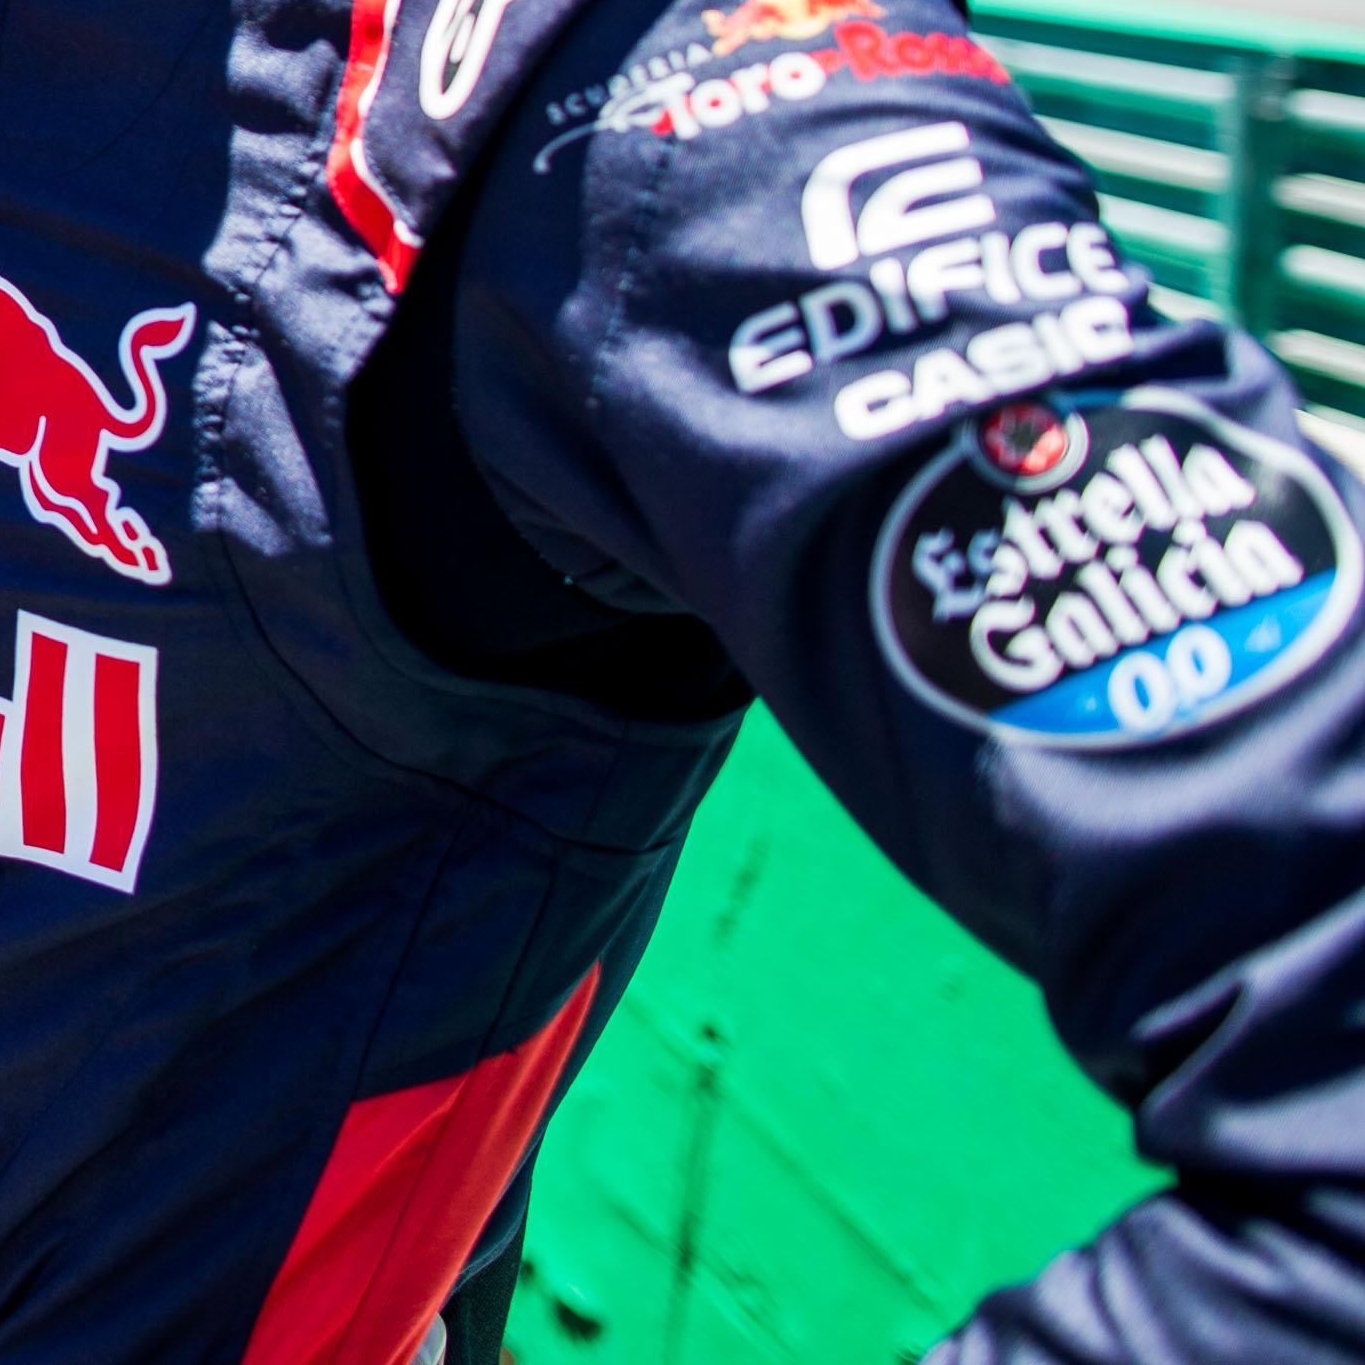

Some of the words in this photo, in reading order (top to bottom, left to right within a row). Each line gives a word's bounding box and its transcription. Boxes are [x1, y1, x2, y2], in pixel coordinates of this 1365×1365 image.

[729, 221, 1130, 394] EDIFICE
[912, 434, 1257, 622] Estrella
[971, 515, 1305, 693] Galicia
